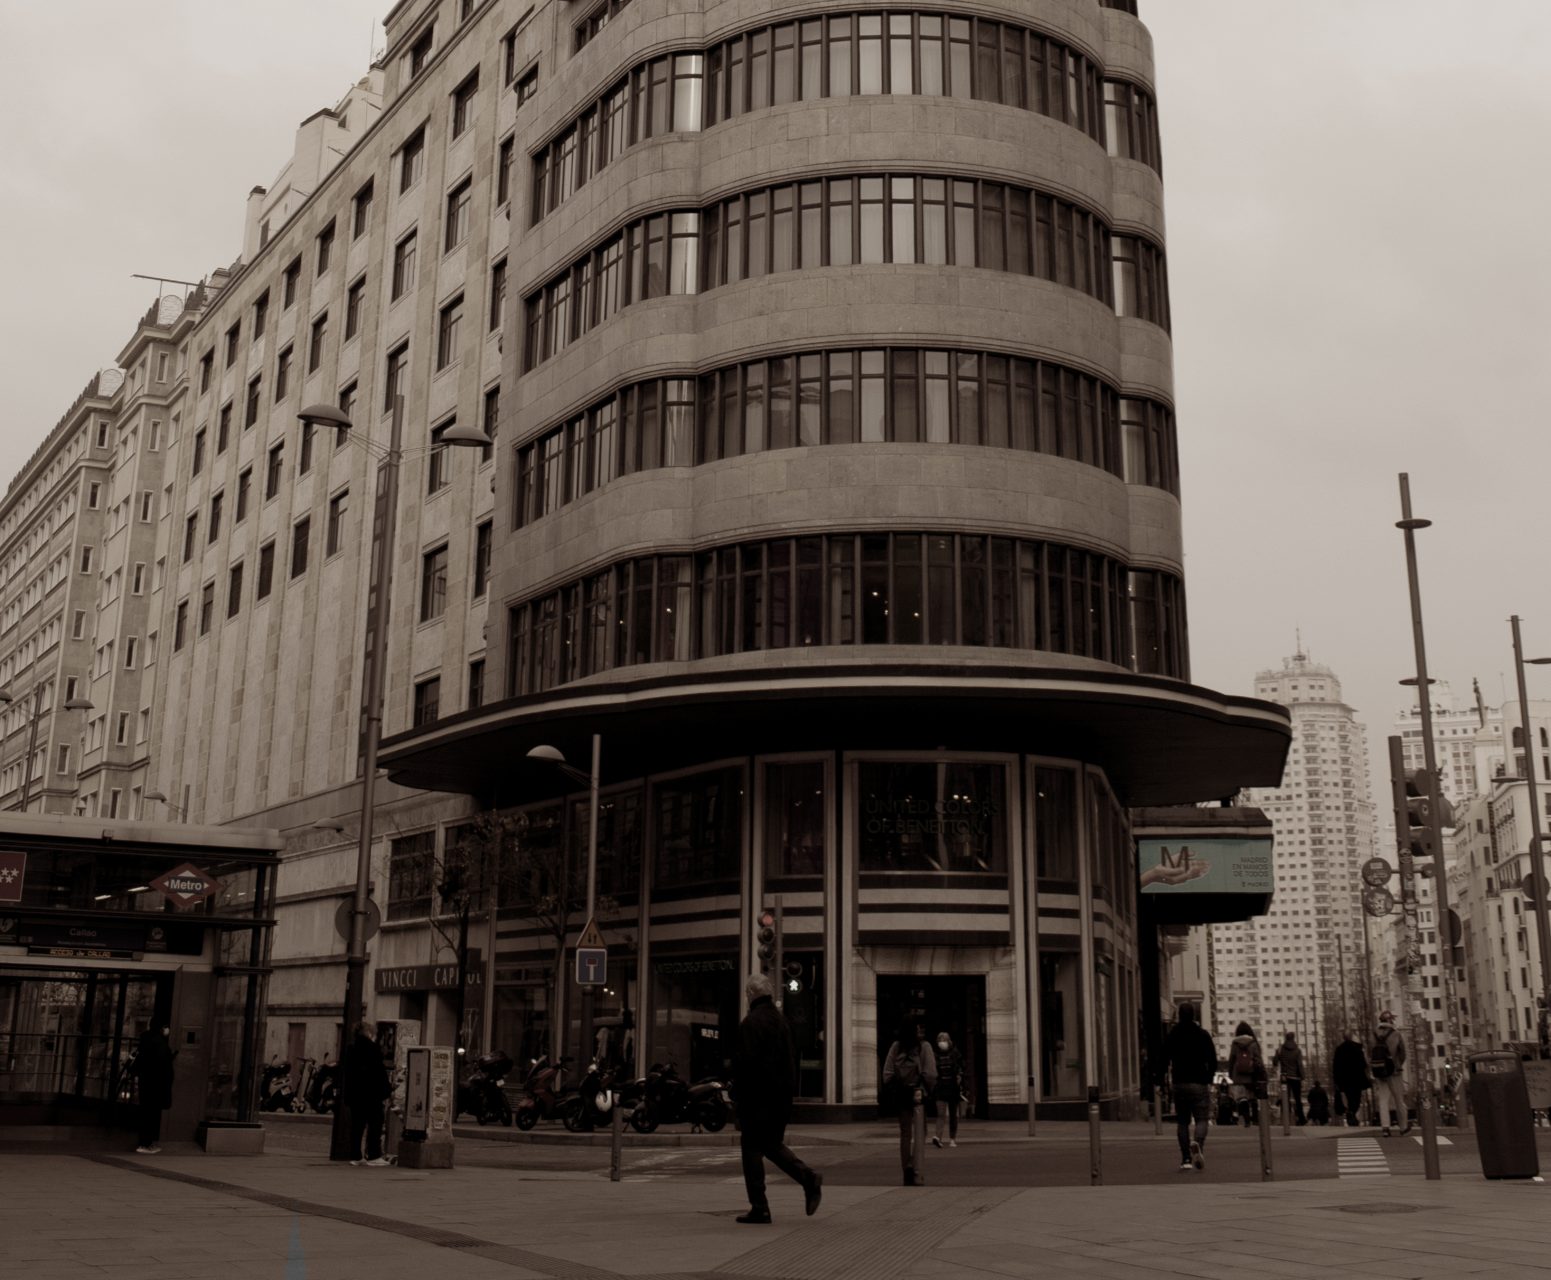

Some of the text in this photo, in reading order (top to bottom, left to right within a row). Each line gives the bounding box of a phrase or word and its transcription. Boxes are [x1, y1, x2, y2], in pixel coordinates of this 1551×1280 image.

[865, 799, 1000, 816] UNITED COLORS
[866, 819, 986, 834] OF BENETTON
[170, 879, 202, 891] Metro
[68, 928, 97, 937] Callao
[382, 967, 481, 988] VINCCI CAPIOL
